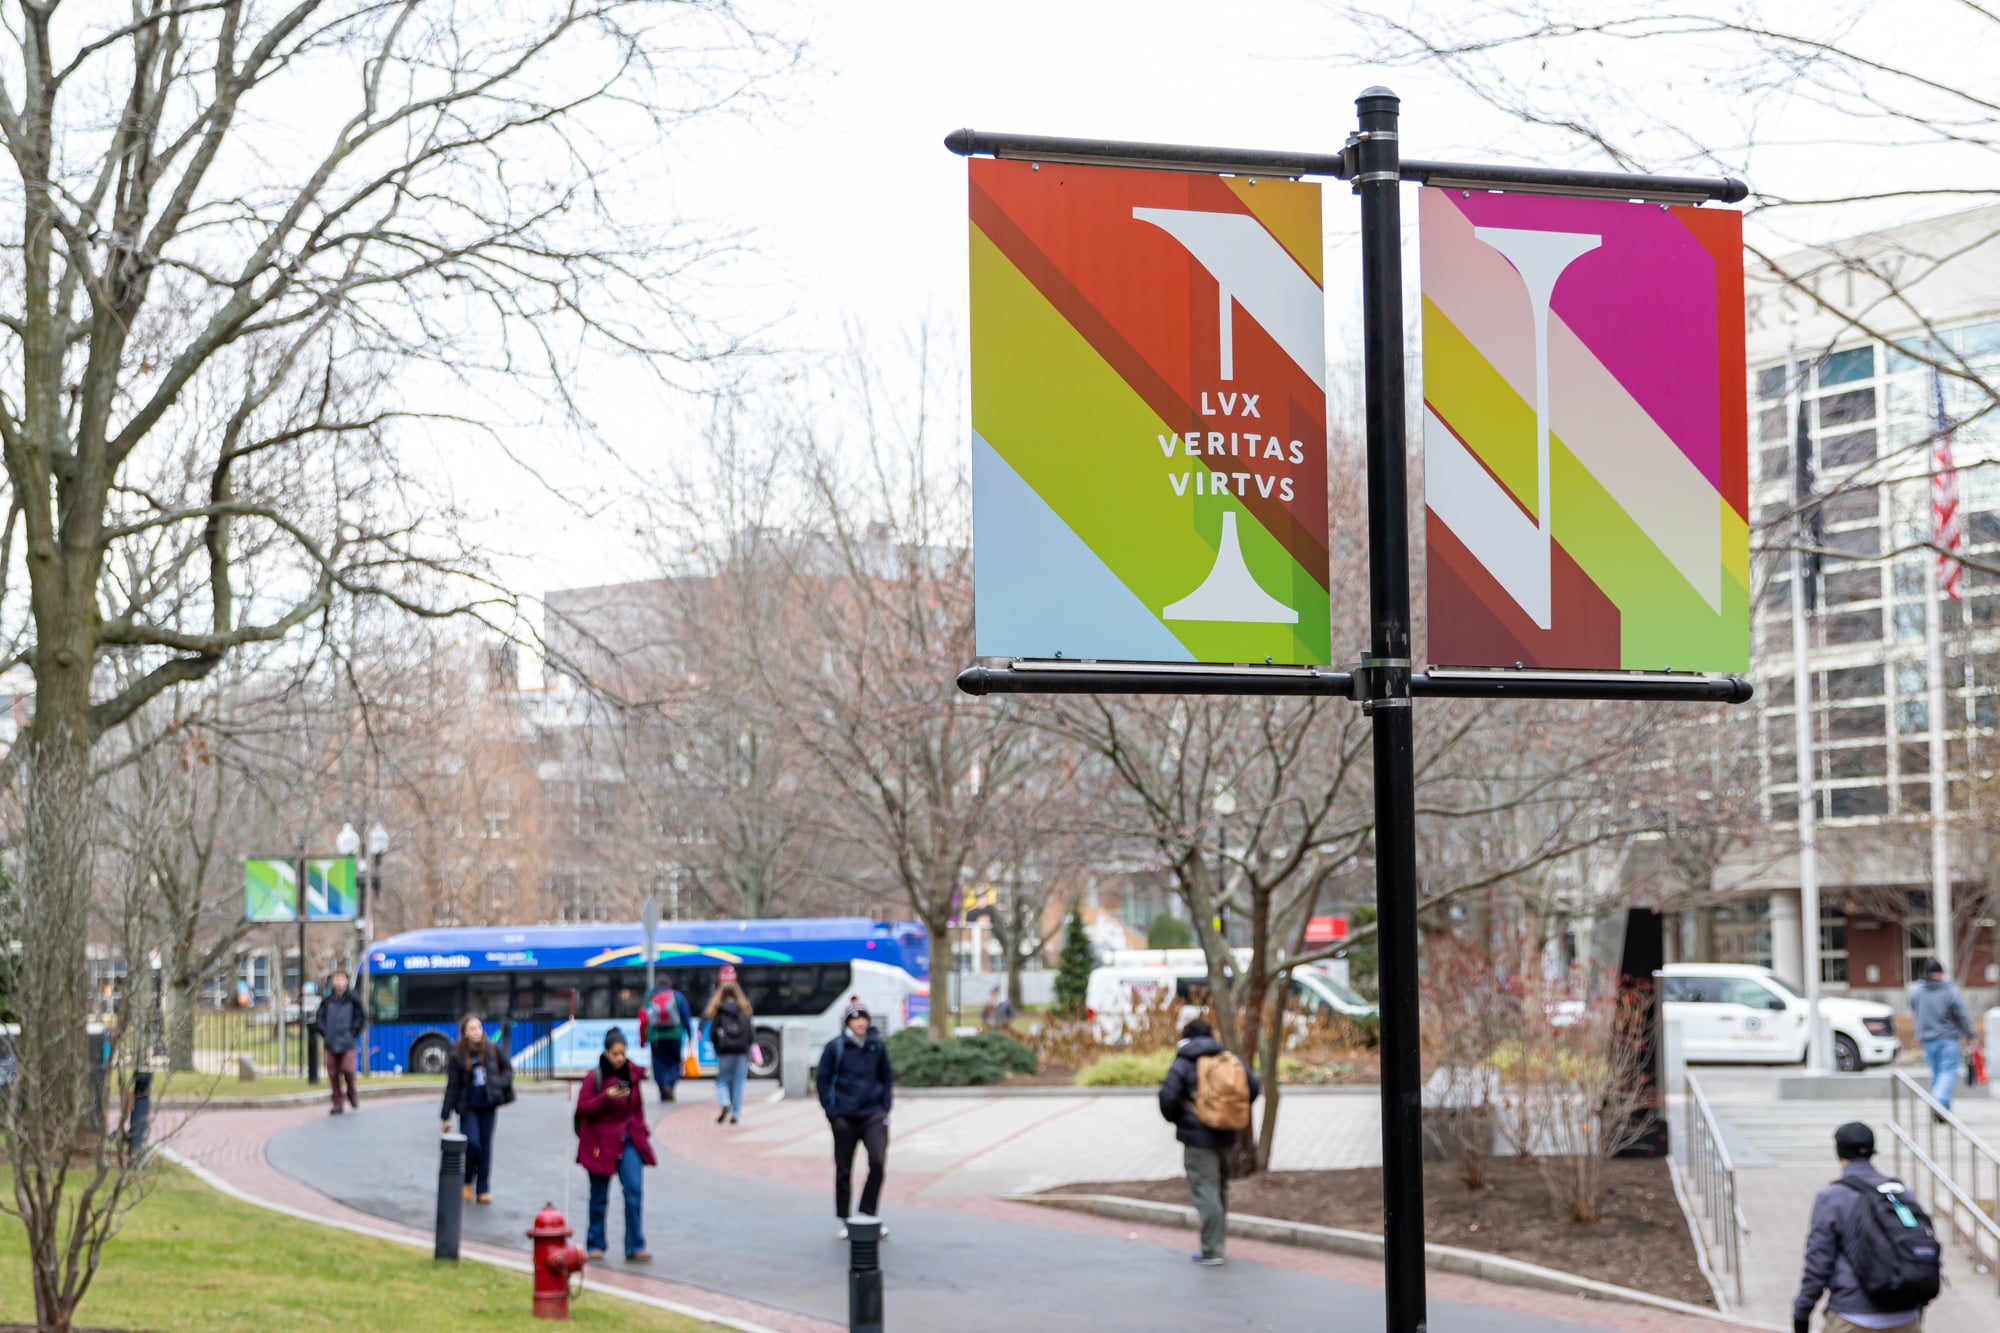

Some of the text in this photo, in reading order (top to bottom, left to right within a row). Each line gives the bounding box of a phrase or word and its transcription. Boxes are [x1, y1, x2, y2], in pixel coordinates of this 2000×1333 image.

[1201, 391, 1261, 419] LVX
[1157, 431, 1305, 464] VERITAS
[1168, 471, 1295, 502] VIRTVS
[430, 954, 470, 968] Shuttle
